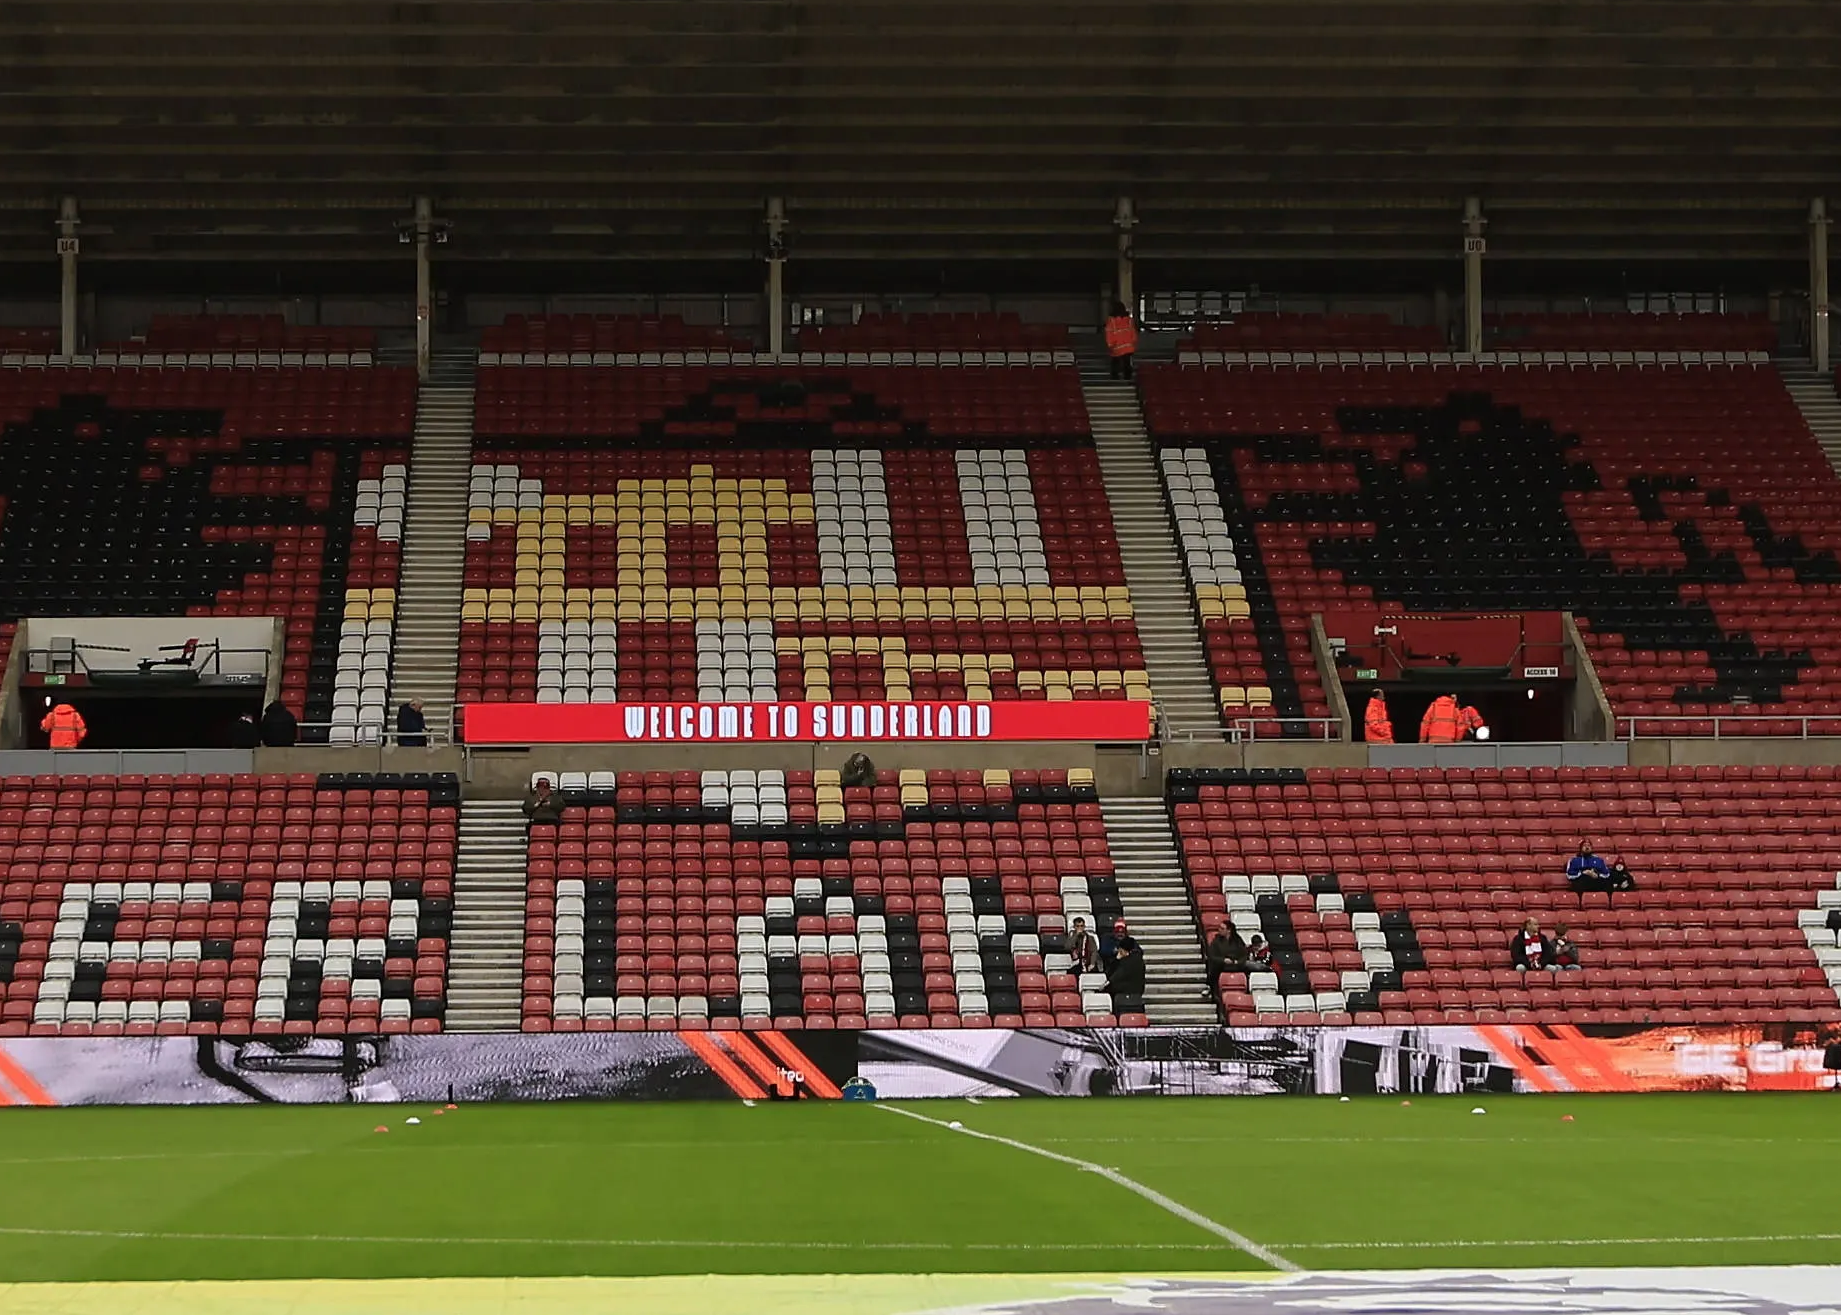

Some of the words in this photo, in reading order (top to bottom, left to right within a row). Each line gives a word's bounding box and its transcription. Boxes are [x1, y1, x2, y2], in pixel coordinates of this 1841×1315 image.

[624, 705, 754, 739] WELCOME
[767, 705, 798, 738] TO
[812, 704, 992, 738] SUNDERLAND
